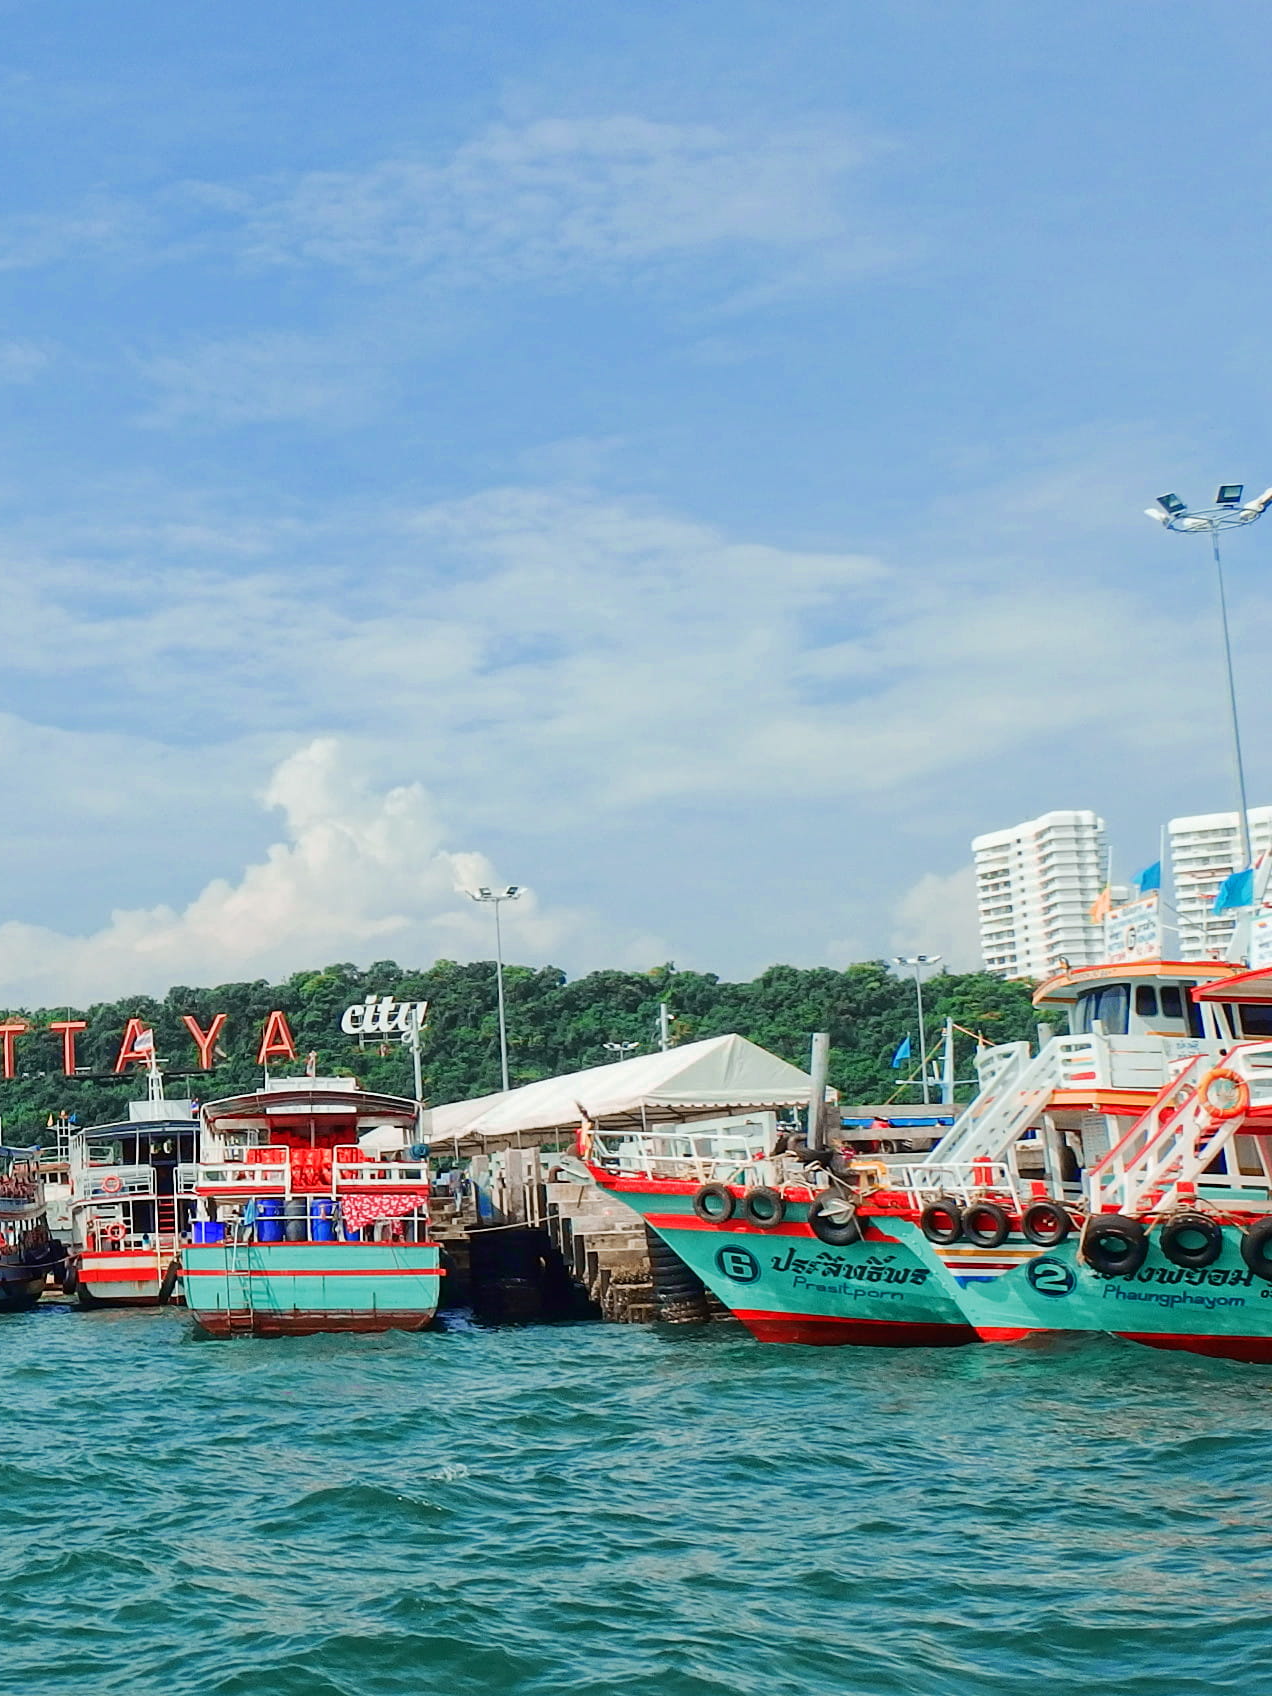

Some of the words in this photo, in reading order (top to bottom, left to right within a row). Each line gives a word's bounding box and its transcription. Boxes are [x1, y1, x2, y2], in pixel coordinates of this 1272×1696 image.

[340, 995, 428, 1044] city
[722, 1250, 755, 1279] 6
[1034, 1263, 1069, 1292] 2
[792, 1275, 905, 1300] Prasitporn
[1102, 1283, 1246, 1309] Phaungphayom
